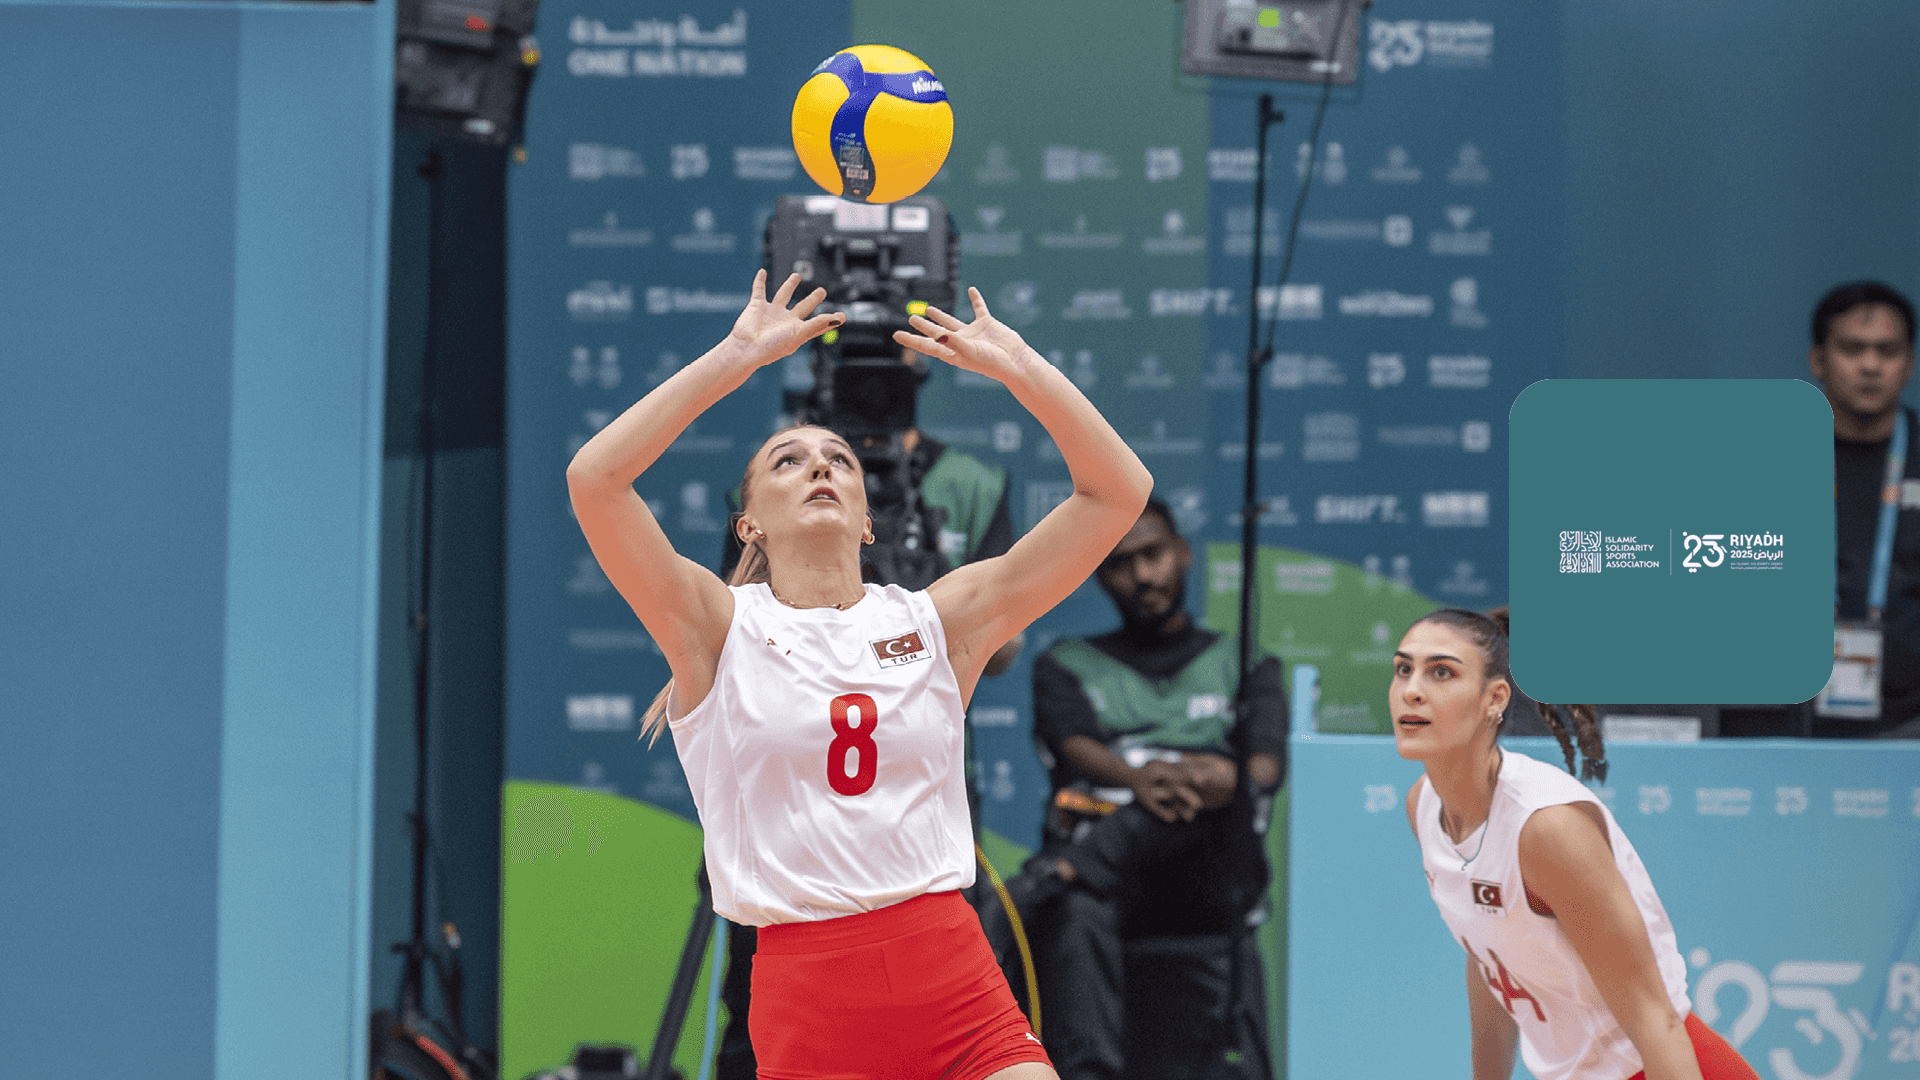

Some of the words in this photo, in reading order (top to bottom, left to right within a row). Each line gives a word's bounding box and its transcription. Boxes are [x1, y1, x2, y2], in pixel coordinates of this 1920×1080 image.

[568, 49, 629, 77] ONE
[633, 49, 747, 77] NATION
[890, 653, 919, 665] TUR
[827, 693, 878, 796] 8
